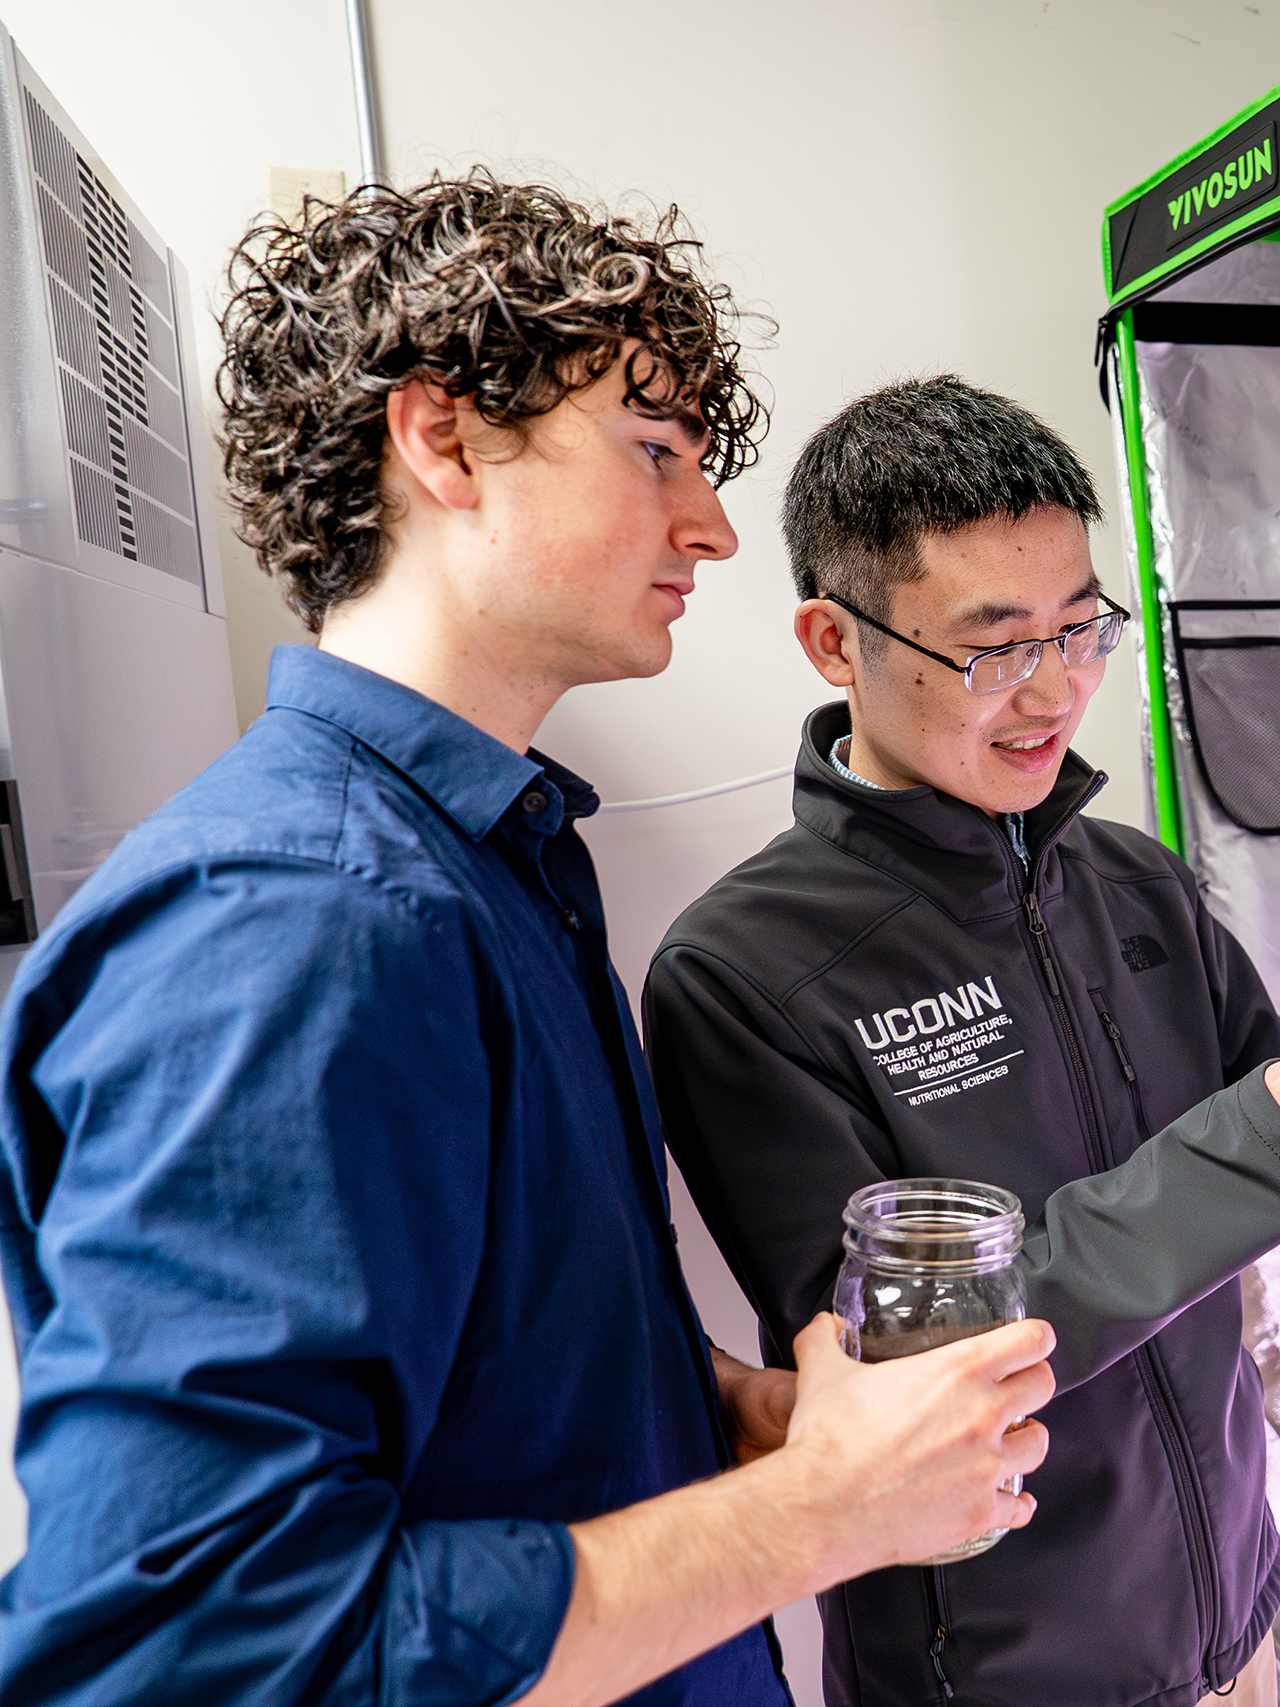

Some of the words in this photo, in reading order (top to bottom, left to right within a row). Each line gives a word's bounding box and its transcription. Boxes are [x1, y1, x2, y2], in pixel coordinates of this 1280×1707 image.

[1167, 138, 1272, 231] VIVOSUN
[854, 976, 1002, 1050] UCONN
[919, 1041, 934, 1054] OF
[936, 1014, 1013, 1049] AGRICULTURE,
[887, 1058, 927, 1076] HEALTH
[928, 1049, 949, 1065] AND
[951, 1030, 1005, 1057] NATURAL
[918, 1053, 980, 1081] RESOURCES
[908, 1083, 961, 1107] NUTRITIONAL
[961, 1065, 1009, 1090] SCIENCES
